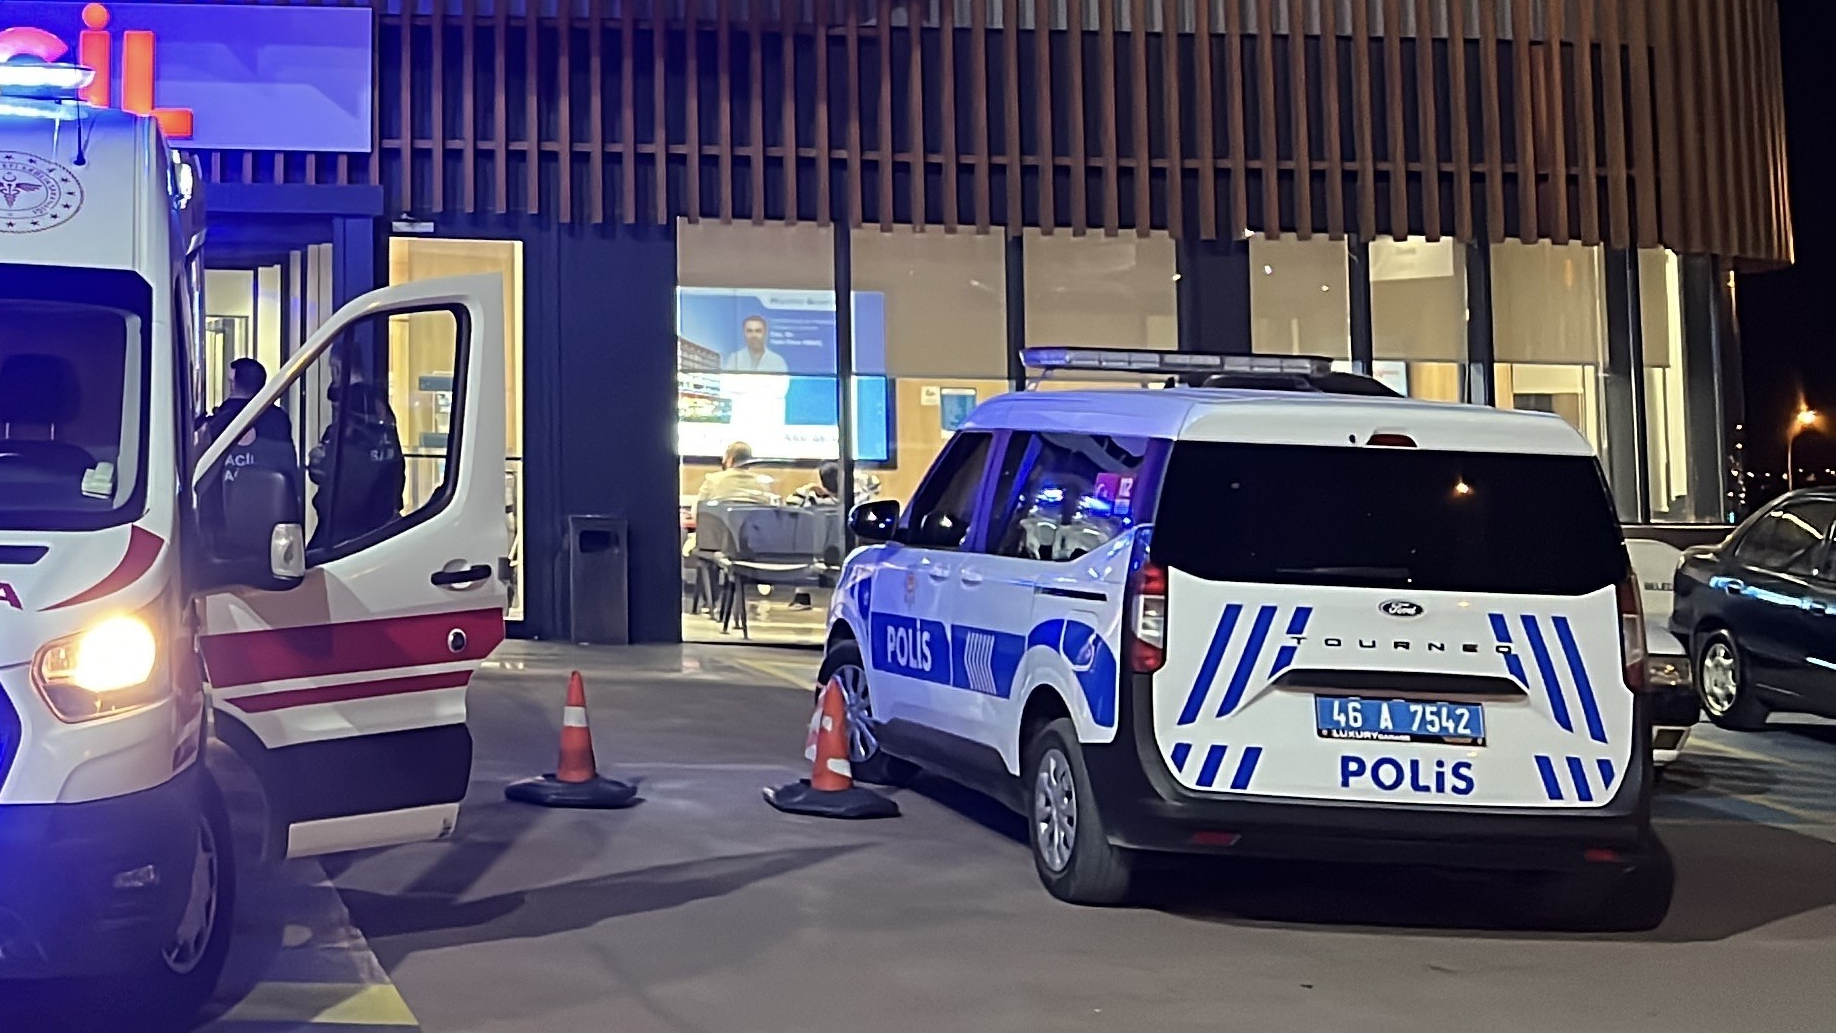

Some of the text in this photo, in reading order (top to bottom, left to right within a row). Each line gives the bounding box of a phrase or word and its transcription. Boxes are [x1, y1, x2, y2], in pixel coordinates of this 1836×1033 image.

[1388, 601, 1417, 617] Ford
[887, 618, 932, 672] POLİS
[1291, 636, 1512, 655] TOURNEO
[1333, 701, 1471, 735] 46 A 7542
[1341, 755, 1475, 796] POLİS
